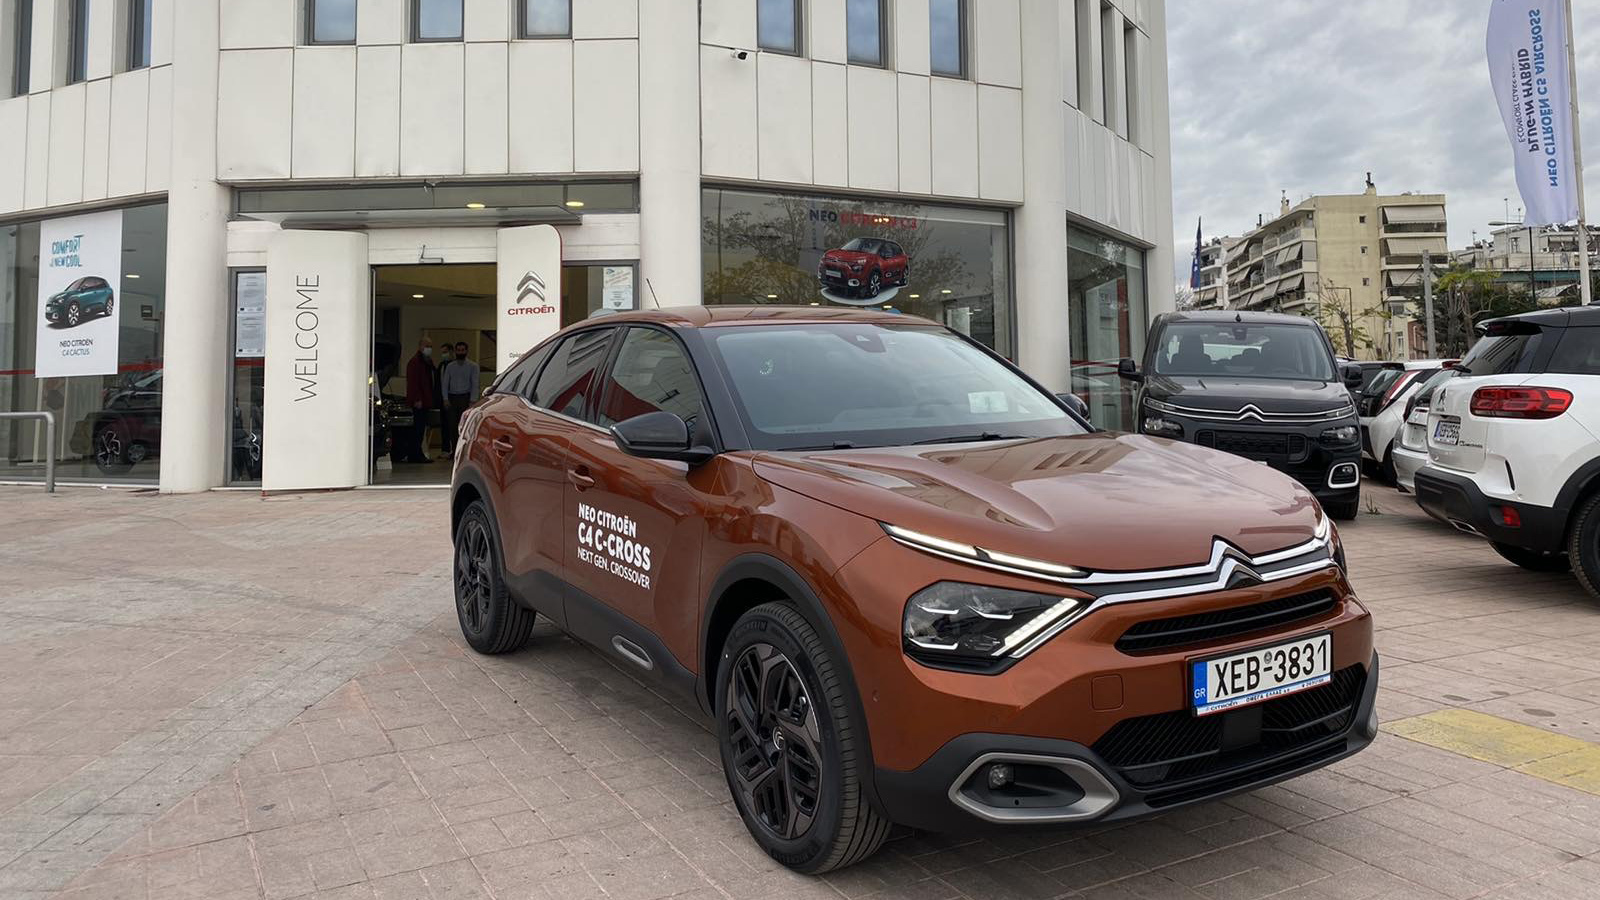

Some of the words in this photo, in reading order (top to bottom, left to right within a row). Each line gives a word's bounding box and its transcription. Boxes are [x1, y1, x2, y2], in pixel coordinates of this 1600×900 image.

[809, 209, 838, 222] NEO
[52, 234, 84, 254] COMFORT
[65, 254, 82, 268] COOL
[294, 275, 319, 402] WELCOME
[578, 502, 596, 523] NEO
[597, 509, 637, 538] CITROËN
[578, 522, 594, 548] C4
[594, 528, 651, 572] C-CROSS
[577, 546, 594, 564] NEXT
[593, 554, 609, 572] GEN.
[610, 561, 651, 590] CROSSOVER
[1194, 687, 1206, 699] GR
